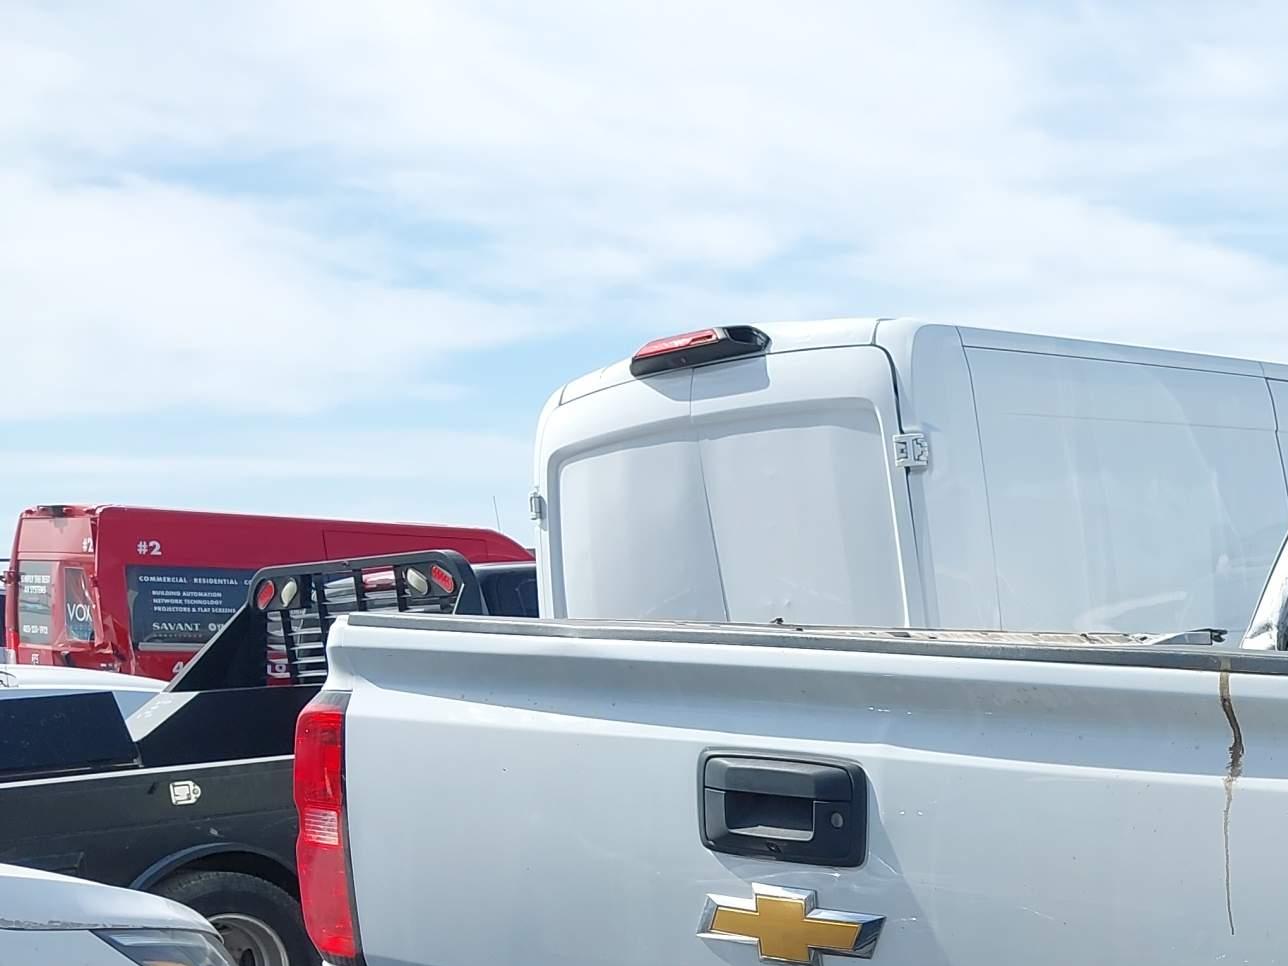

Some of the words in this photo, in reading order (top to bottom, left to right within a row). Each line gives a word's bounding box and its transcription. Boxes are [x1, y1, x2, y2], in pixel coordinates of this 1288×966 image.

[136, 541, 162, 556] #2
[138, 575, 187, 584] COMMERCIAL
[193, 577, 238, 585] RESIDENTIAL
[152, 622, 201, 632] SAVANT
